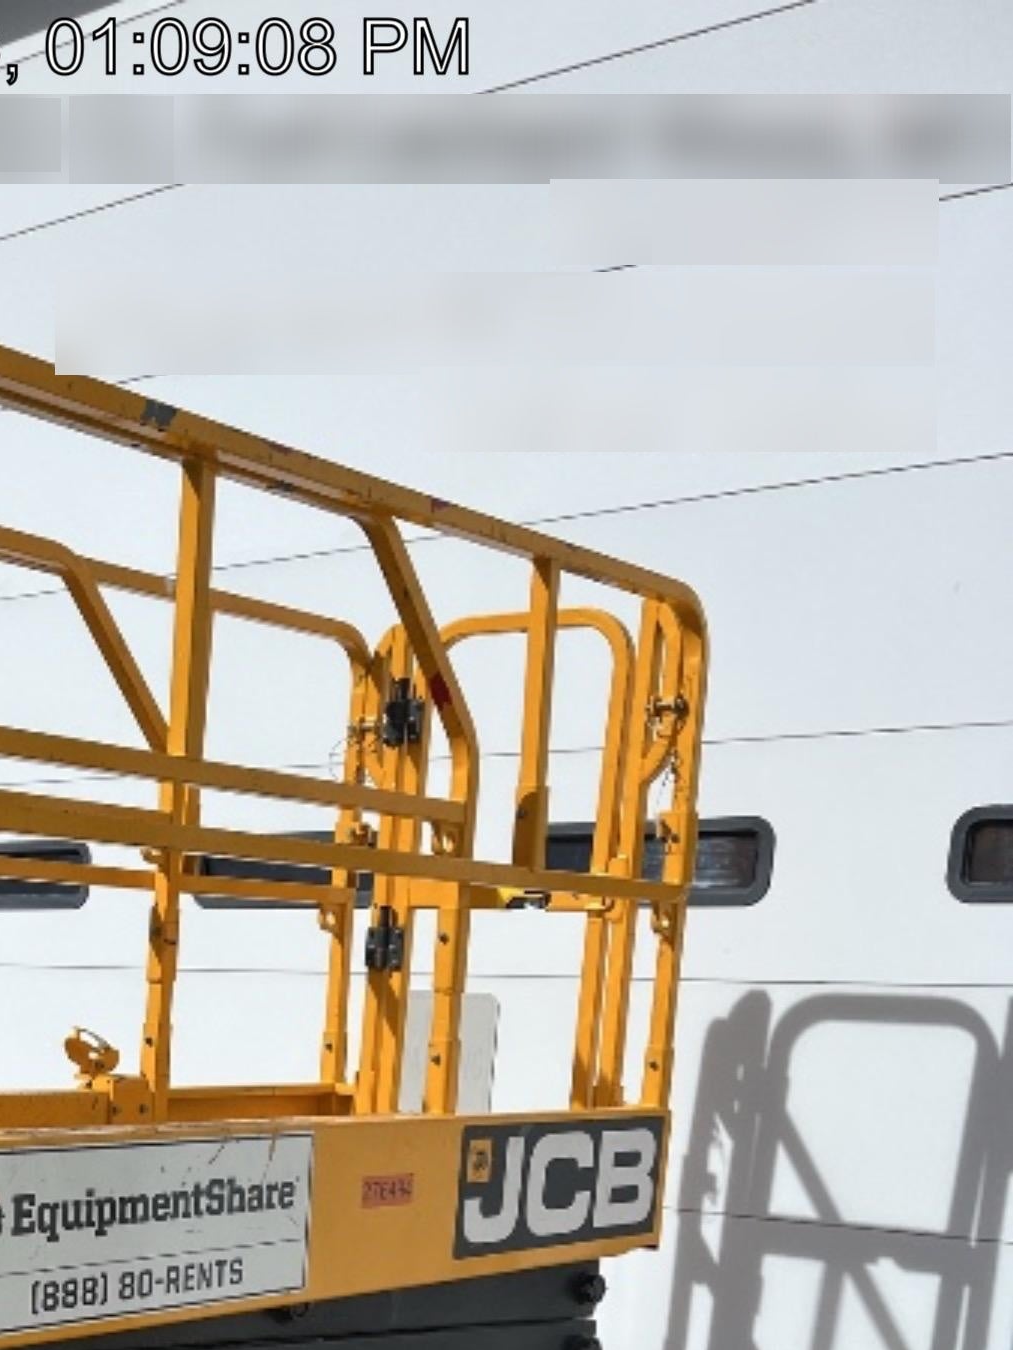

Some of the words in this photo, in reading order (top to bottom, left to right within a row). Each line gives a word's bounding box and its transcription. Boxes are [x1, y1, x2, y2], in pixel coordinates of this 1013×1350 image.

[10, 1177, 296, 1243] EquipmentShare
[463, 1127, 658, 1244] JCB
[31, 1270, 109, 1315] (888)
[118, 1256, 243, 1301] 80-RENTS
